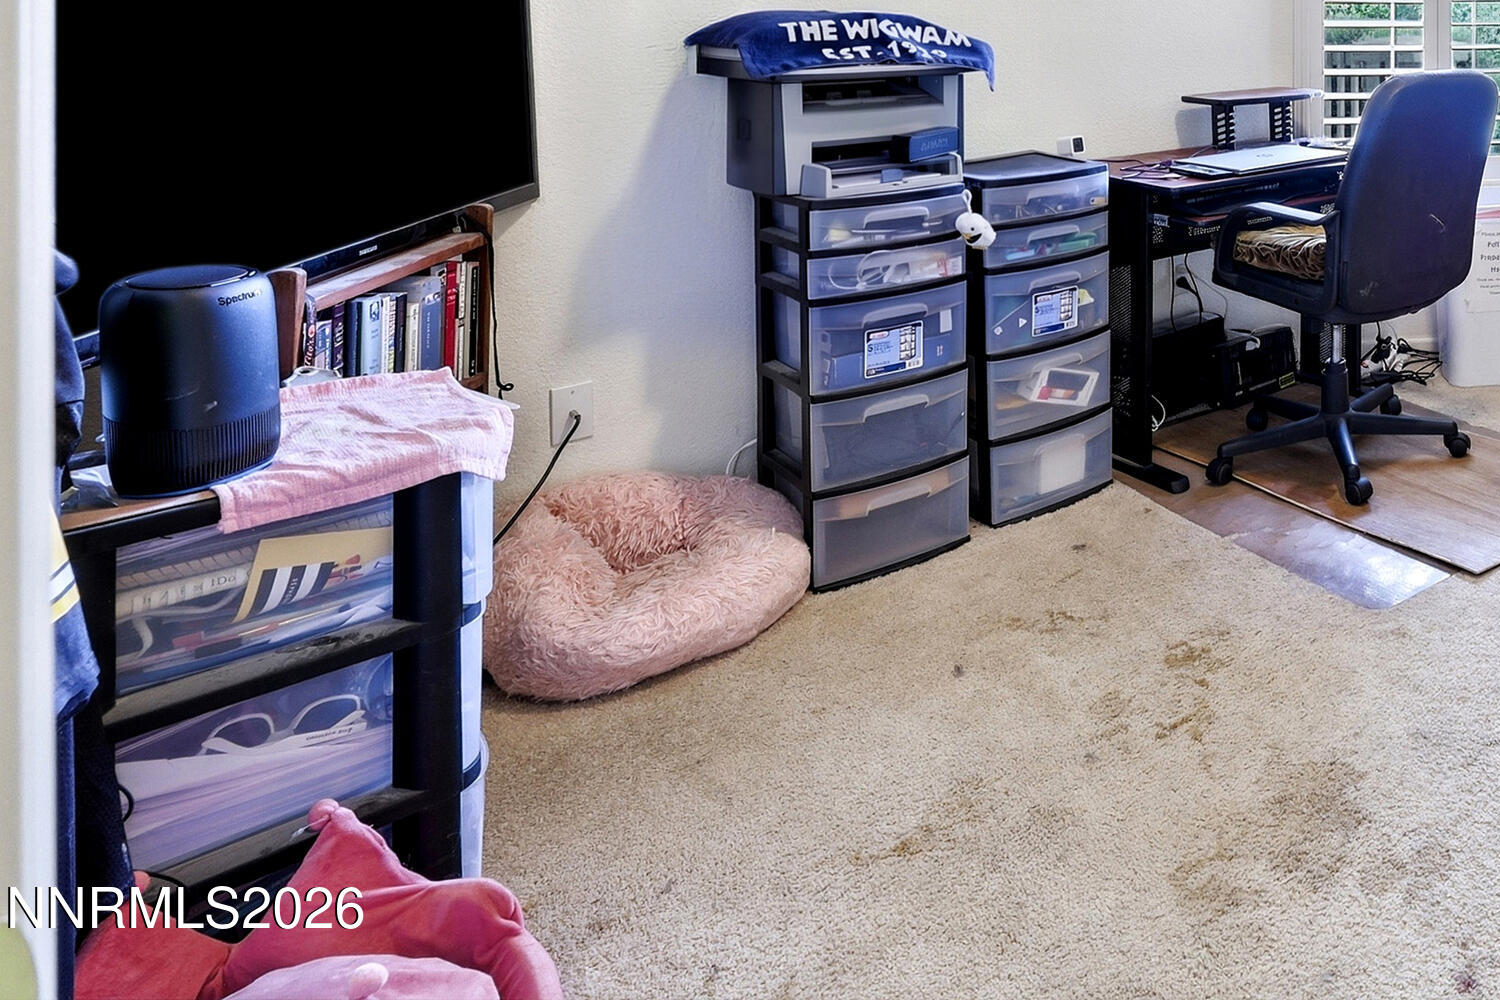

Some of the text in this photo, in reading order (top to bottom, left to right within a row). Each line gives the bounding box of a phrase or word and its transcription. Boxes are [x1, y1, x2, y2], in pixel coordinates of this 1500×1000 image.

[777, 17, 972, 48] THE WIGWAM
[821, 45, 872, 60] EST
[217, 289, 263, 306] Spectrum
